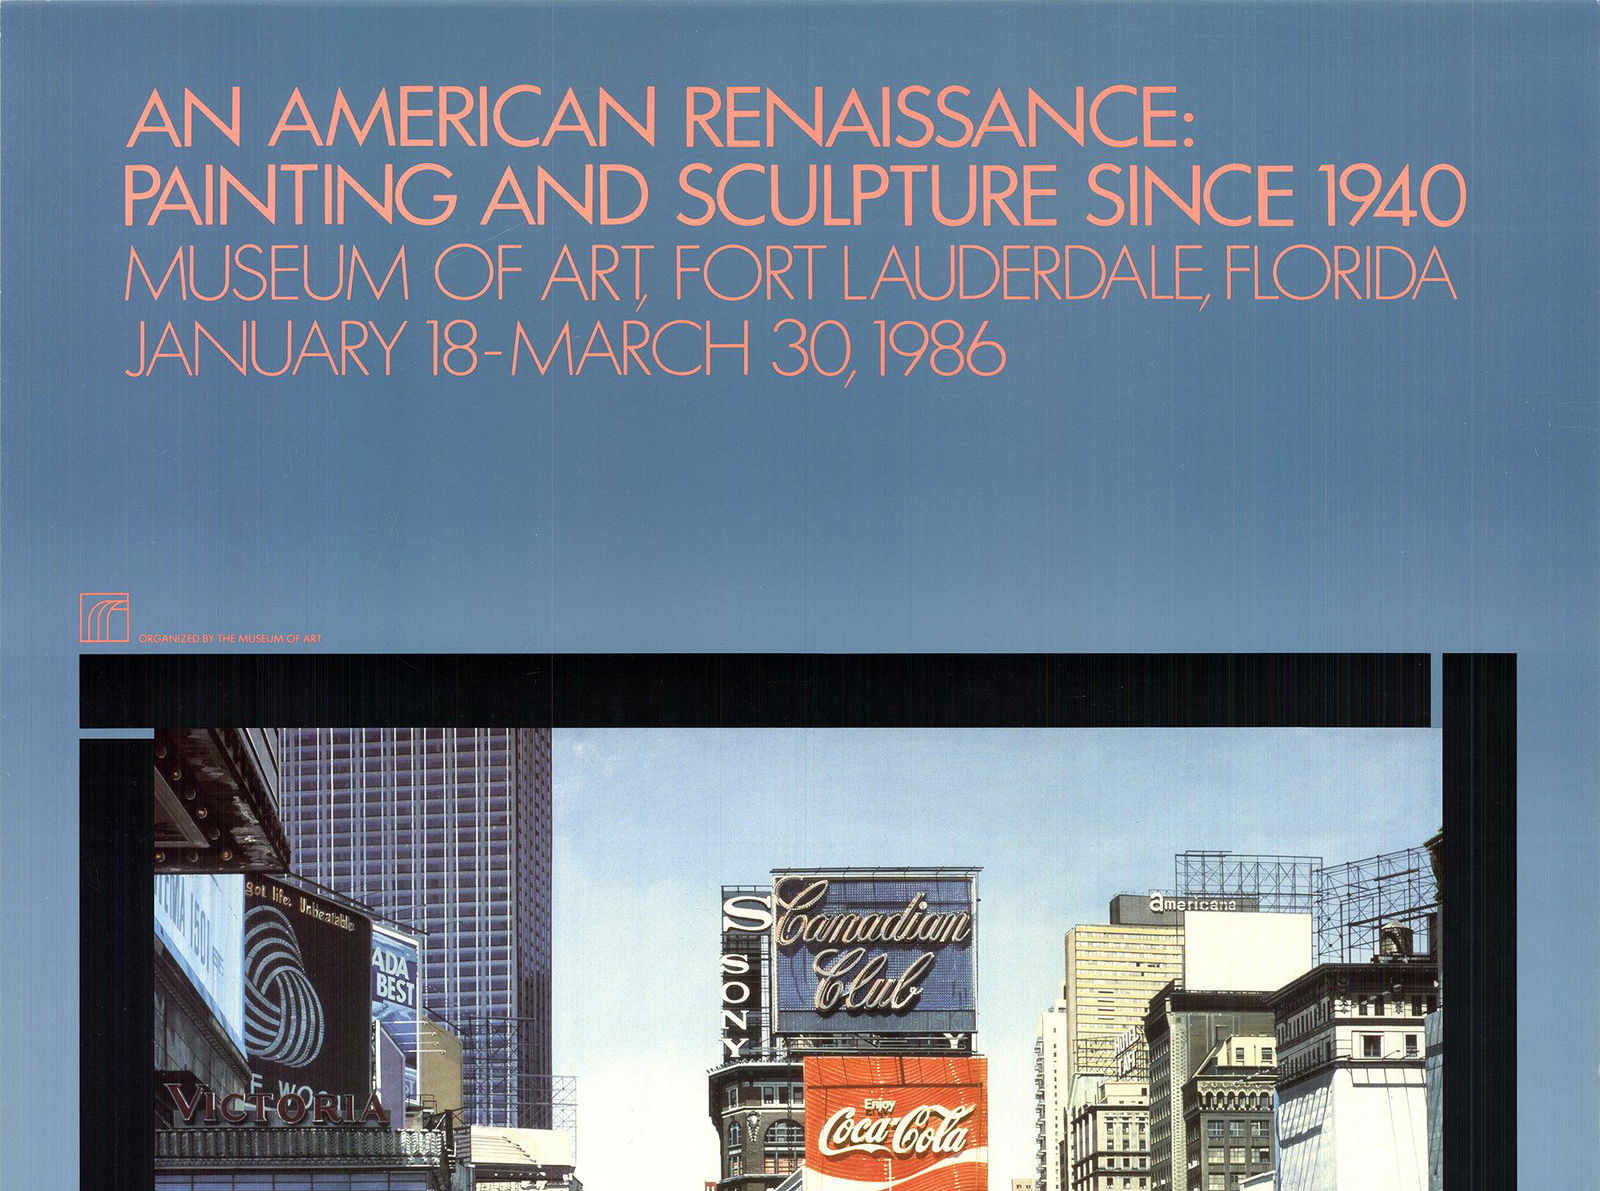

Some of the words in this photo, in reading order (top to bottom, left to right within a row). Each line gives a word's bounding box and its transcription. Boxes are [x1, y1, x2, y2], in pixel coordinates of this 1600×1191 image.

[127, 86, 241, 148] AN
[268, 84, 657, 148] AMERICAN
[686, 84, 1195, 148] RENAISSANCE:
[124, 163, 458, 227] PAINTING
[480, 163, 649, 226] AND
[677, 163, 1058, 227] SCULPTURE
[1086, 163, 1294, 227] SINCE
[1318, 163, 1467, 227] 1940
[124, 244, 409, 301] MUSEUM
[435, 243, 523, 301] OF
[541, 244, 655, 312] ART,
[676, 244, 828, 301] FORT
[843, 244, 1212, 311] LAUDERDALE,
[1226, 243, 1458, 301] FLORIDA
[125, 320, 409, 378] JANUARY
[772, 318, 857, 388] 30,
[873, 319, 1008, 377] 1986
[138, 633, 200, 644] ORGANIZED
[202, 633, 214, 643] BY
[217, 633, 235, 643] THE
[238, 633, 284, 643] MUSEUM
[286, 633, 300, 643] OF
[303, 633, 322, 643] ART
[246, 881, 267, 898] got
[775, 876, 972, 946] Canadian
[1149, 891, 1237, 913] americana
[376, 972, 415, 1006] BEST
[720, 954, 751, 1058] SONY
[813, 947, 935, 1013] Club
[163, 1083, 391, 1125] VICTORIA
[818, 1104, 978, 1157] Coca-Cola
[864, 1098, 896, 1112] Enjoy
